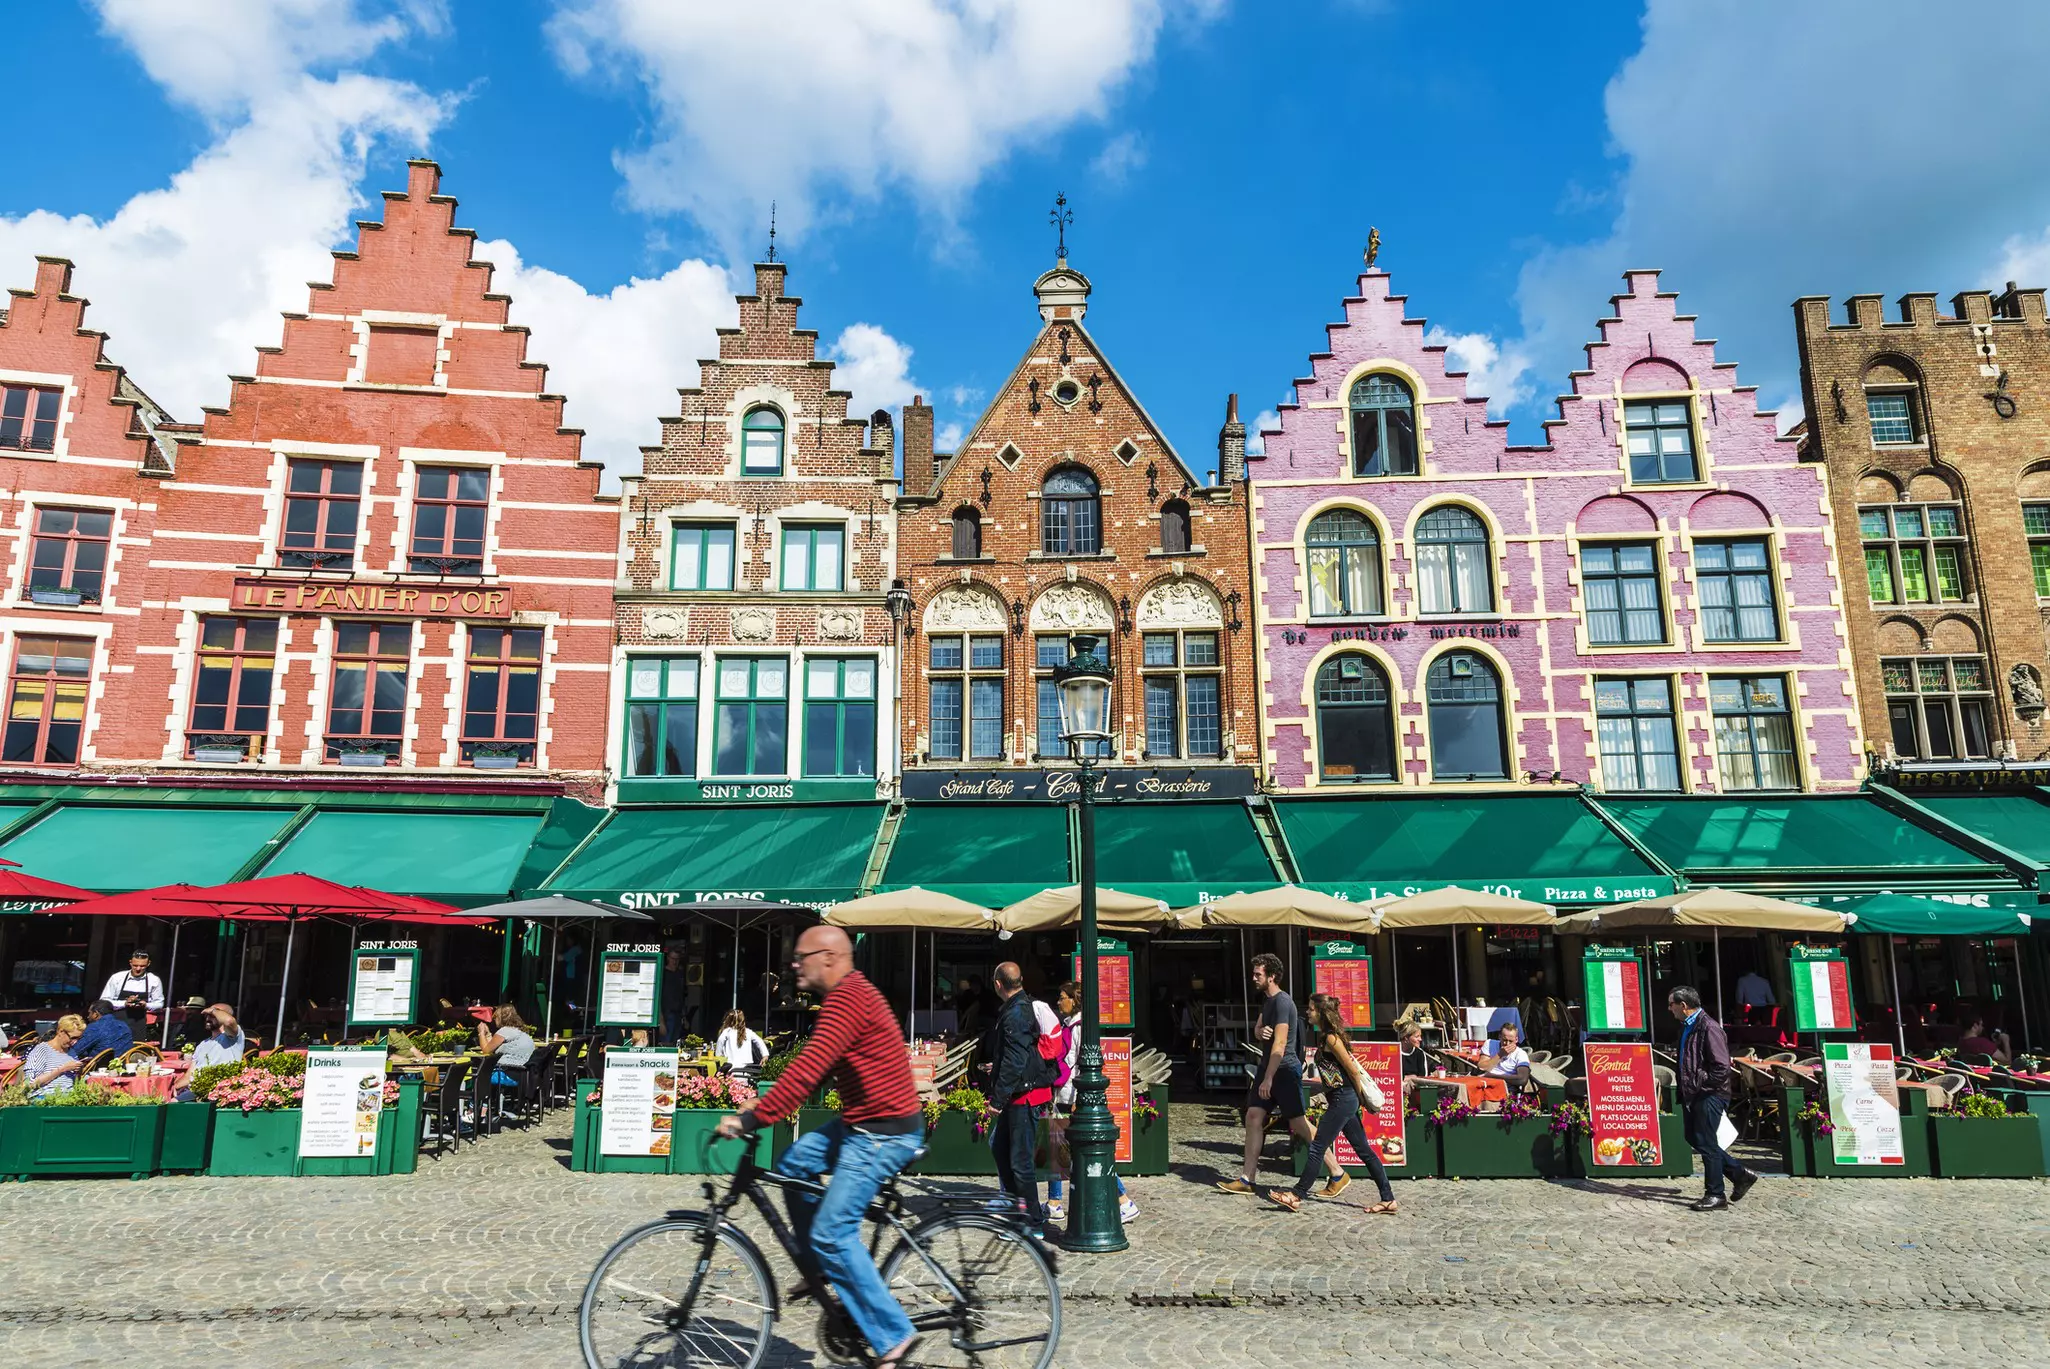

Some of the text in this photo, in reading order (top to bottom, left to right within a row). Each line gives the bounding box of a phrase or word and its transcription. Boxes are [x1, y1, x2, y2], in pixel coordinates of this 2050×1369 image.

[243, 586, 504, 614] LE PANIER D'OR
[940, 779, 982, 798] Grand
[1046, 772, 1107, 798] Cenal
[1136, 777, 1211, 793] Brasserie
[702, 785, 793, 799] SINT JORIS
[1545, 885, 1657, 901] Pizza & pasta
[619, 891, 680, 910] SINT
[780, 899, 845, 911] Basseri
[360, 940, 418, 949] SINT JORIS
[606, 943, 661, 952] SINT JORIS
[1102, 1052, 1129, 1060] MENU
[313, 1058, 341, 1067] Drinks
[640, 1059, 670, 1068] Snacks
[1590, 1054, 1632, 1074] Central
[1373, 1077, 1395, 1085] UNCH
[1600, 1095, 1646, 1103] MOSSELMENU
[1855, 1097, 1873, 1105] Carne
